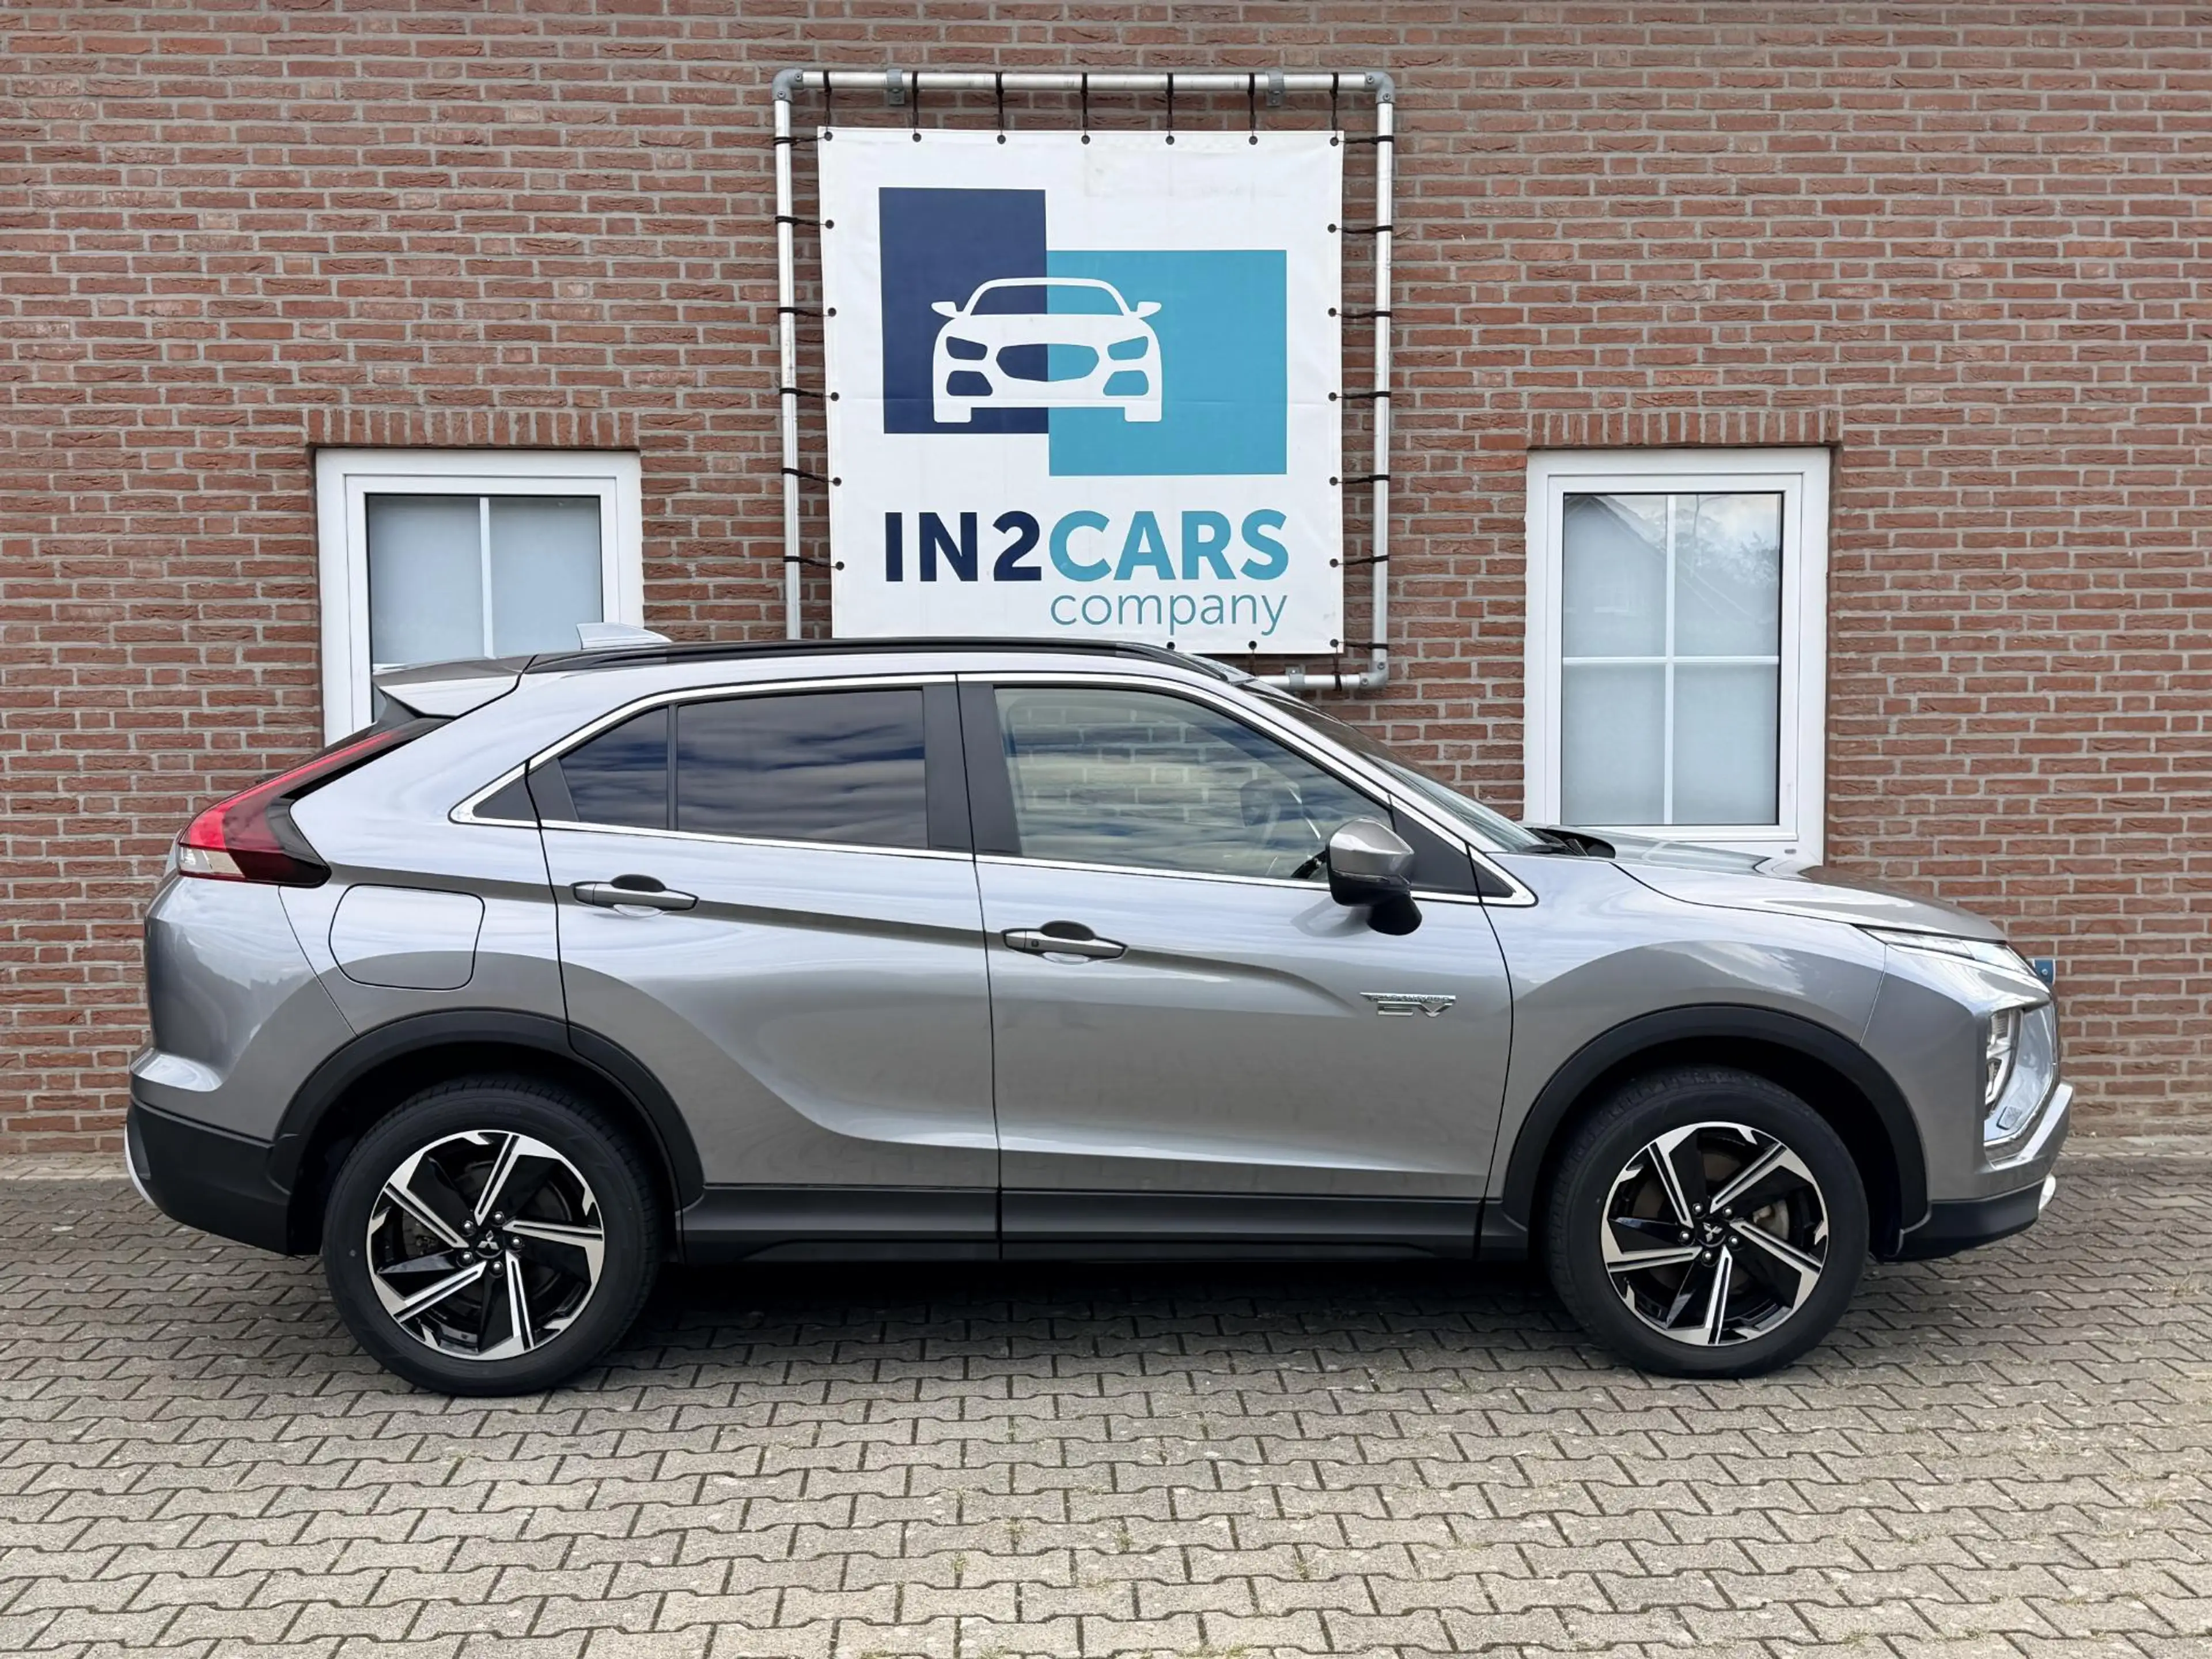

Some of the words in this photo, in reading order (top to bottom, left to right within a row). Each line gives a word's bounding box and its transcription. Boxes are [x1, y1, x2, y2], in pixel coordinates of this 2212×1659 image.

[885, 509, 1289, 582] IN2CARS
[1050, 594, 1288, 636] company
[1377, 1001, 1453, 1017] EV
